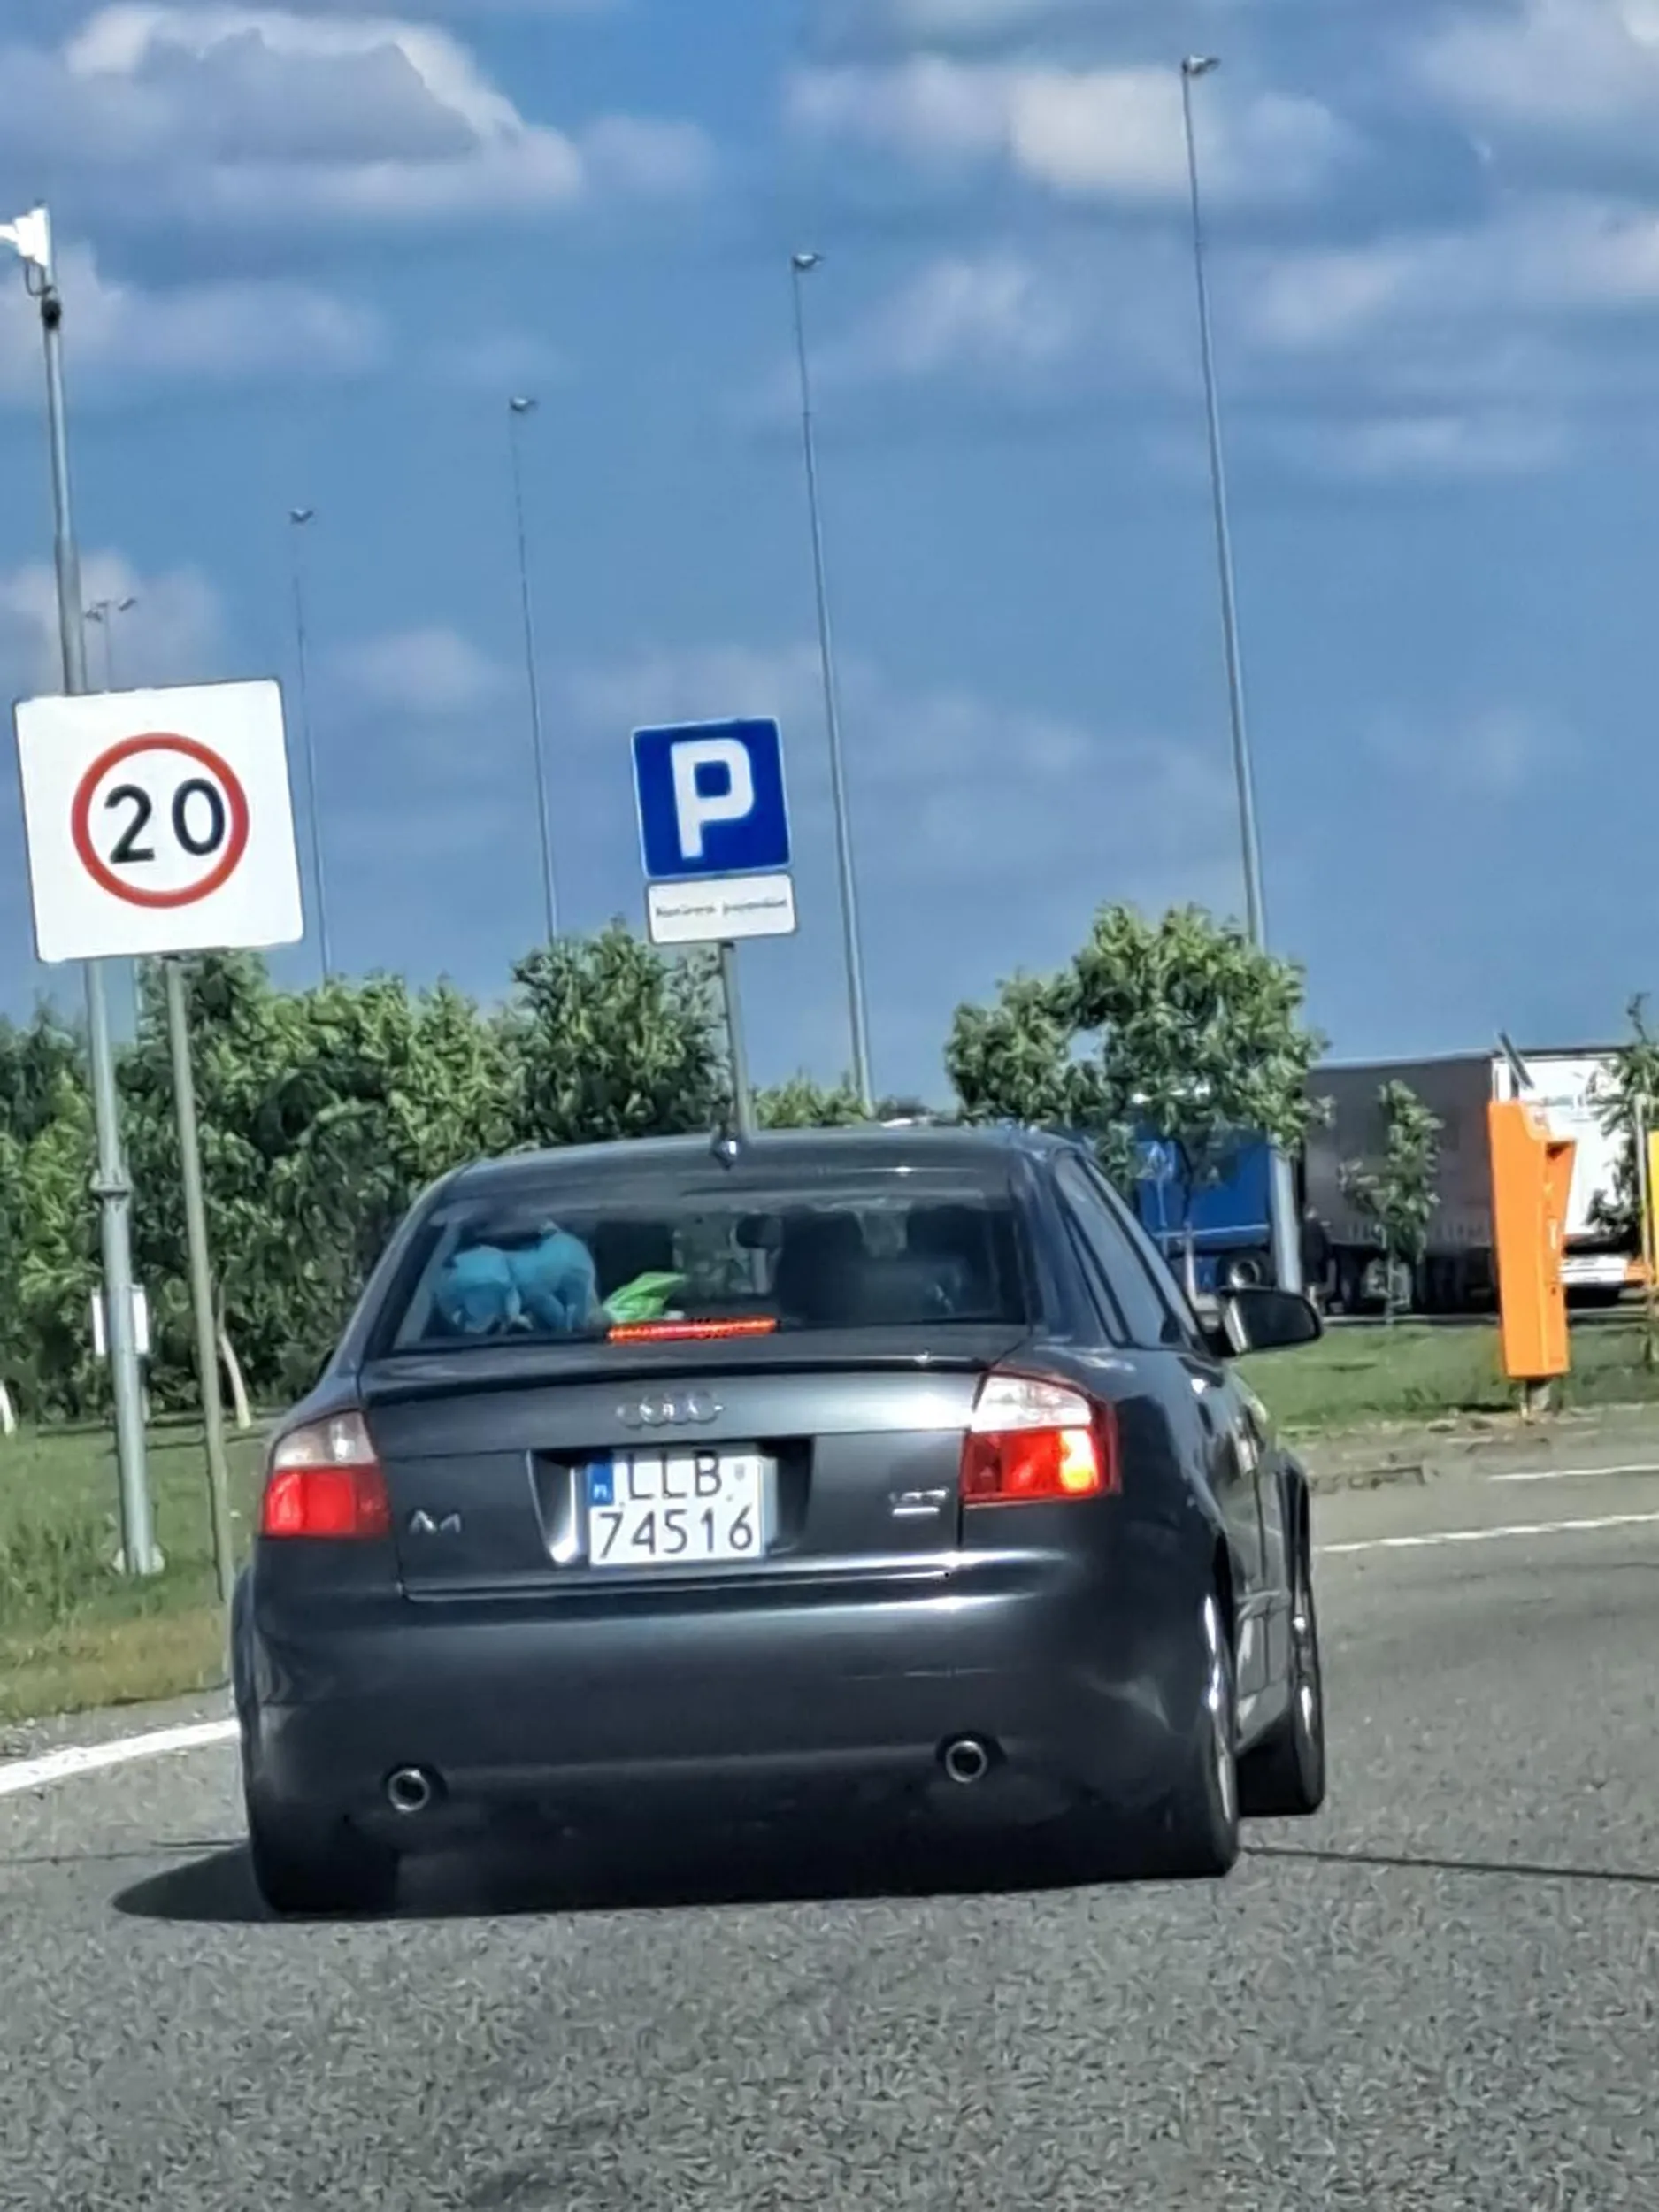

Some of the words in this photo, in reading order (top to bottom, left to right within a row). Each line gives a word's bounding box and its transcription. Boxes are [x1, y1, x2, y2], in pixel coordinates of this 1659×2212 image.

[104, 778, 225, 864] 20
[671, 738, 754, 859] P
[627, 1450, 722, 1500] LLB
[599, 1504, 753, 1558] 74516
